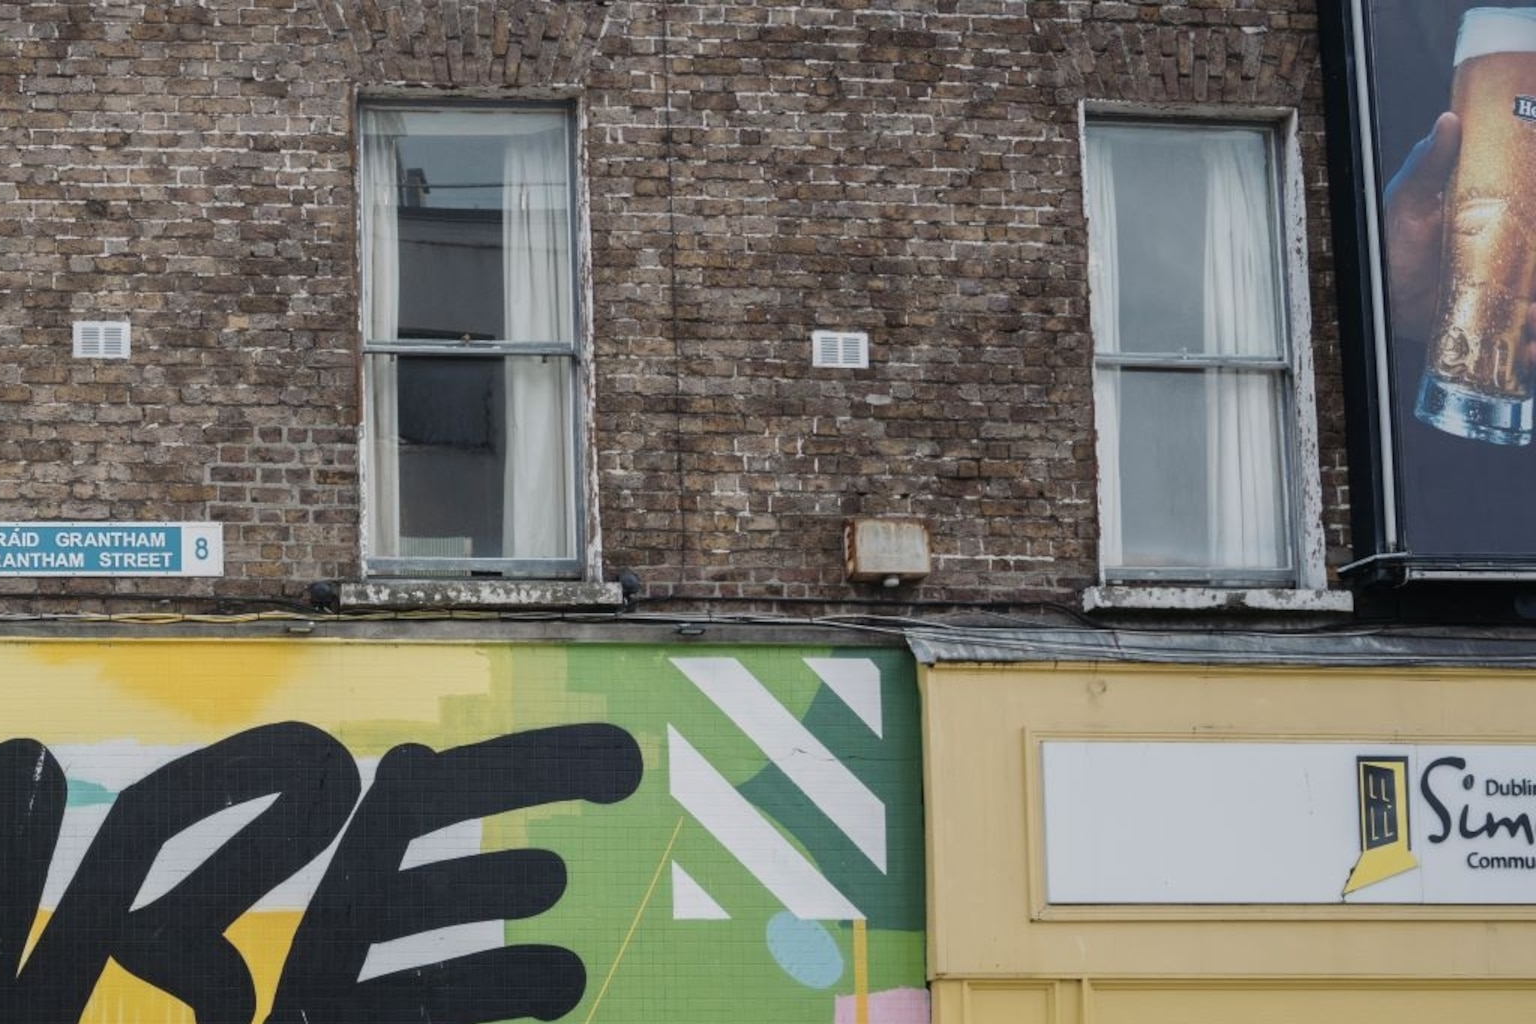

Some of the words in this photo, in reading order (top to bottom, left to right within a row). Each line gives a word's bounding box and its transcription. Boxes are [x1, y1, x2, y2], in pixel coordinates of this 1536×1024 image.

[55, 532, 165, 547] GRANTHAM
[194, 537, 208, 560] 8
[99, 552, 173, 568] STREET
[1420, 756, 1536, 845] Sim
